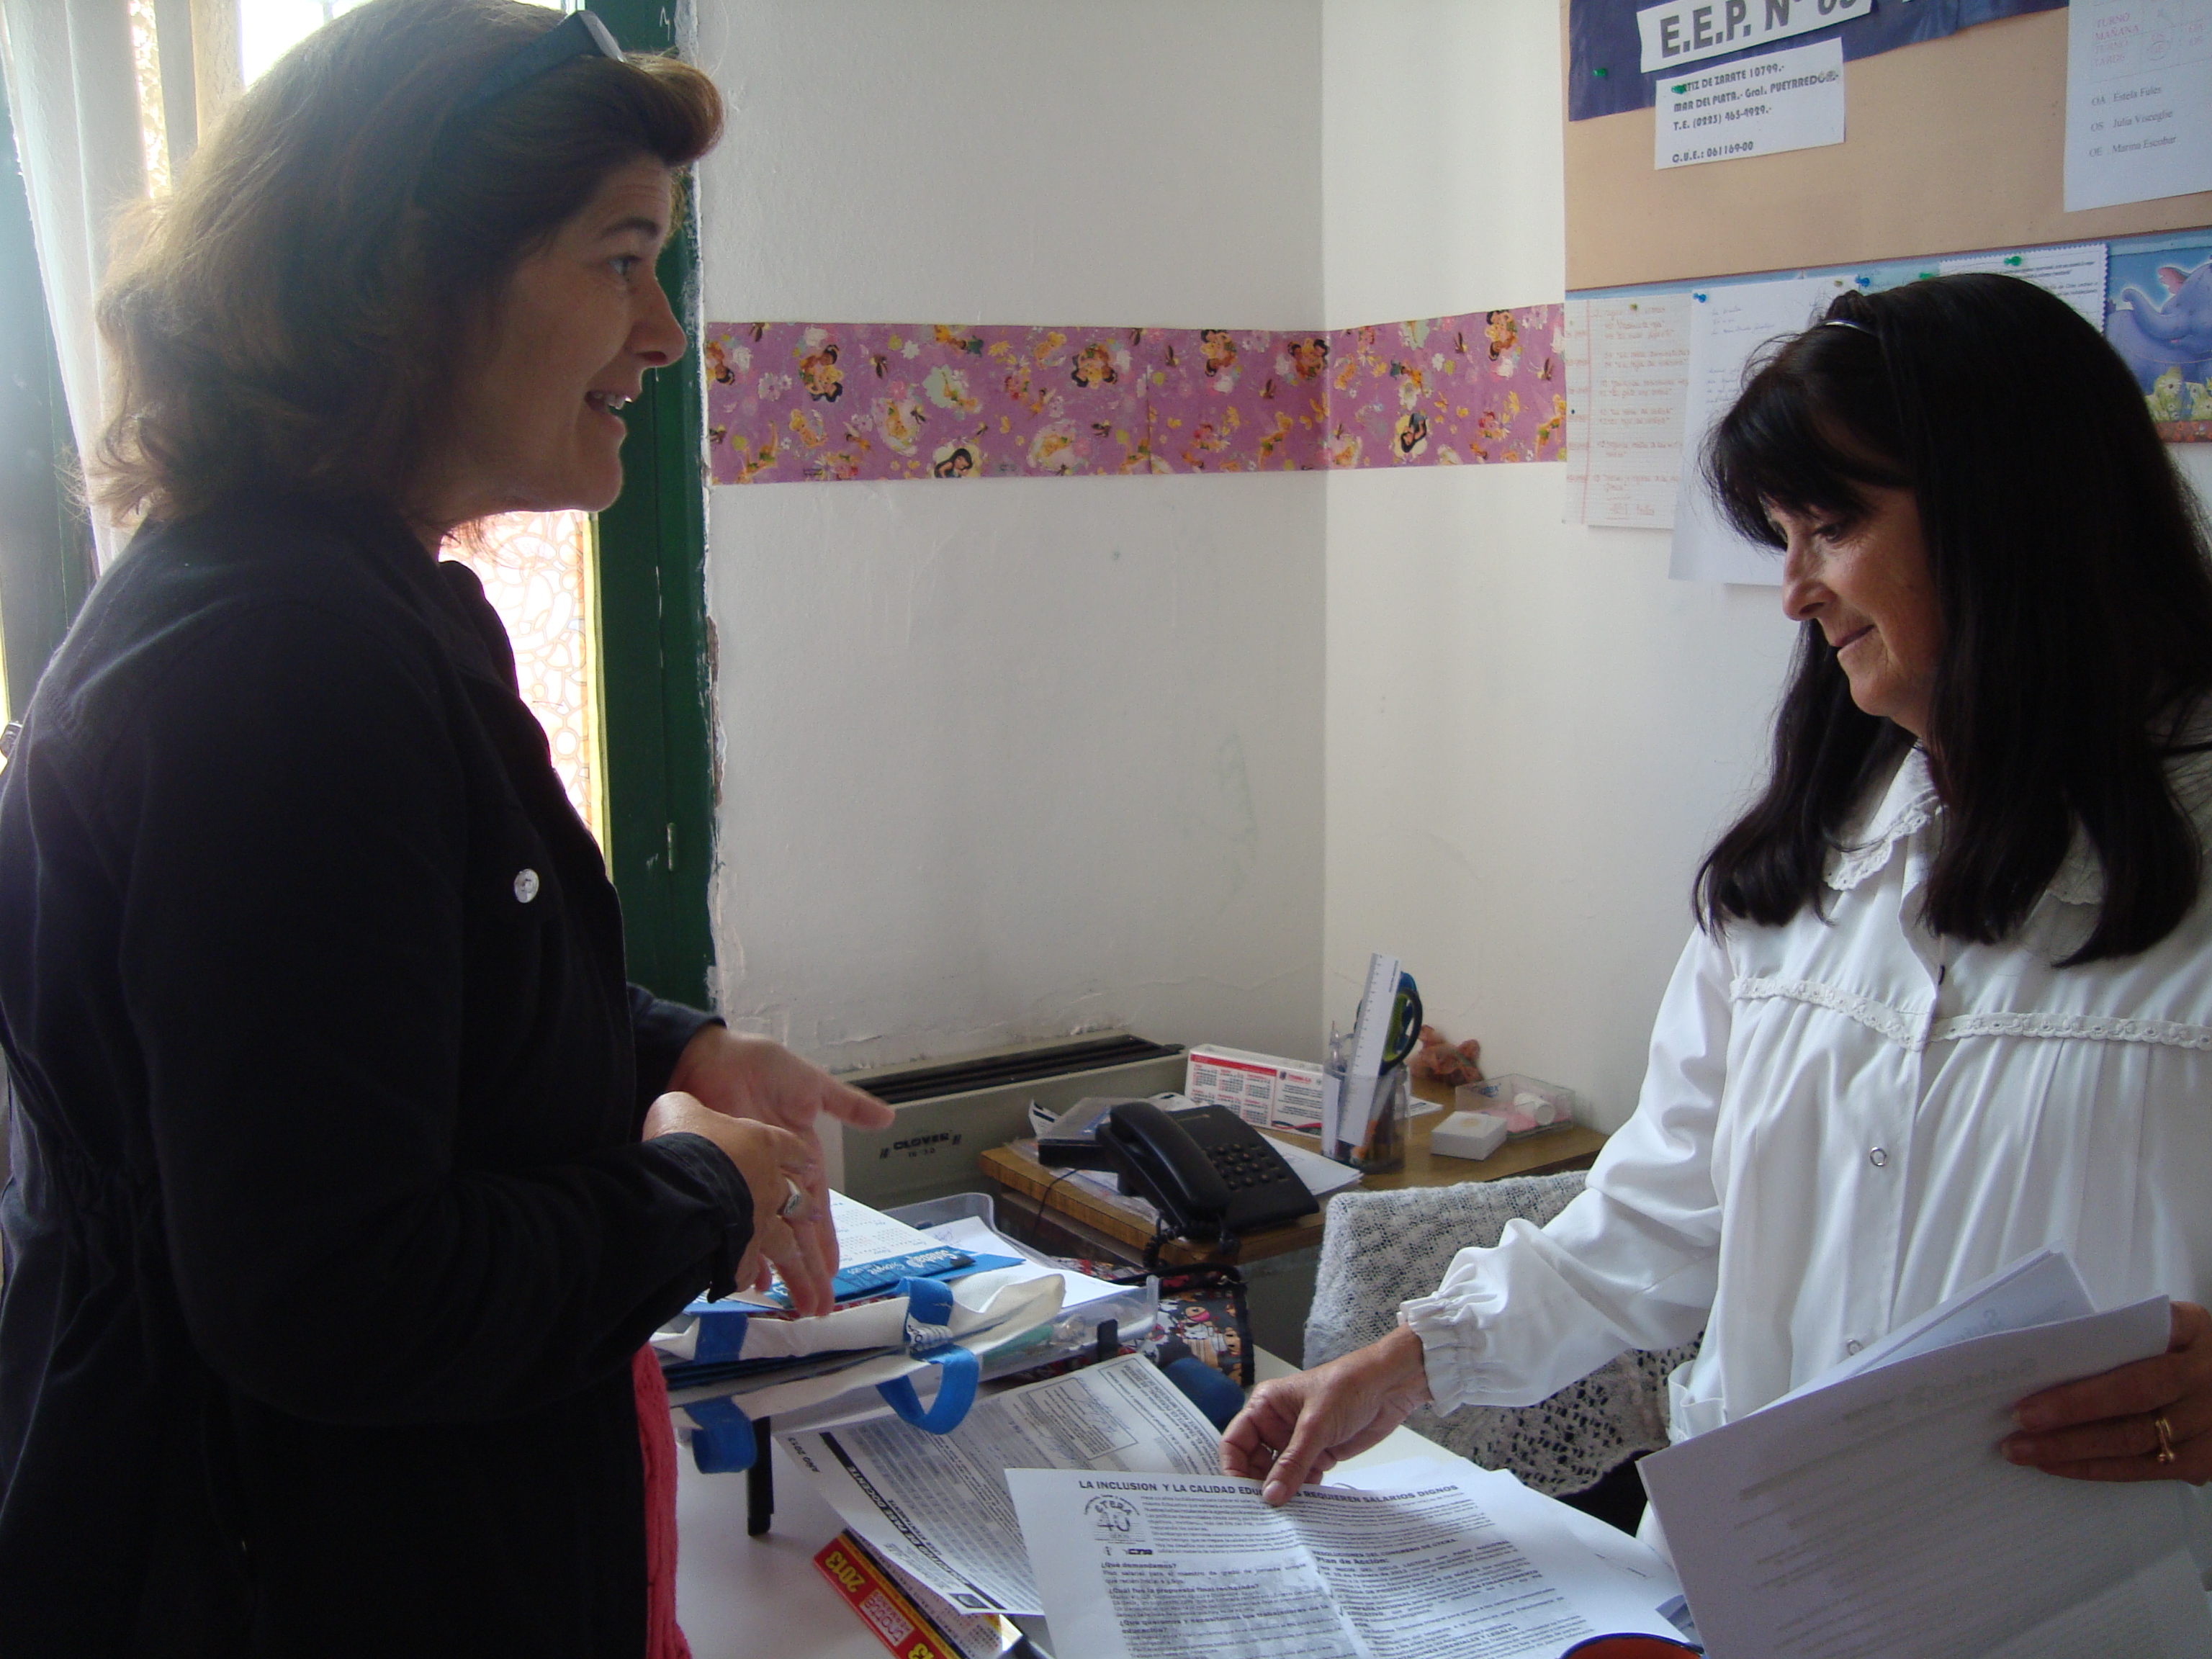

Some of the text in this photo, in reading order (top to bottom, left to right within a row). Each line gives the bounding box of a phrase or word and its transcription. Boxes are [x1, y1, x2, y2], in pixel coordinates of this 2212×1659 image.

[1660, 0, 1751, 58] E.E.P.
[1675, 81, 1699, 93] RTIZ
[1701, 78, 1713, 89] DE
[1714, 70, 1747, 86] ZARATE
[1673, 101, 1694, 112] MAR
[1696, 96, 1712, 108] DEL
[1745, 86, 1768, 99] Gral.
[1673, 121, 1691, 131] T.E.
[1672, 151, 1704, 163] C.U.E.:
[847, 1465, 886, 1506] DOCENTE
[1079, 1480, 1094, 1490] LA
[1097, 1480, 1157, 1492] INCLUSION
[1163, 1483, 1170, 1492] Y
[1174, 1484, 1187, 1493] LA
[1190, 1484, 1236, 1495] CALIDAD
[1303, 1490, 1361, 1503] REQUIEREN
[1363, 1492, 1416, 1503] SALARIOS
[1418, 1485, 1459, 1496] DIGNOS
[825, 1551, 865, 1593] 2013
[864, 1596, 906, 1643] trotta
